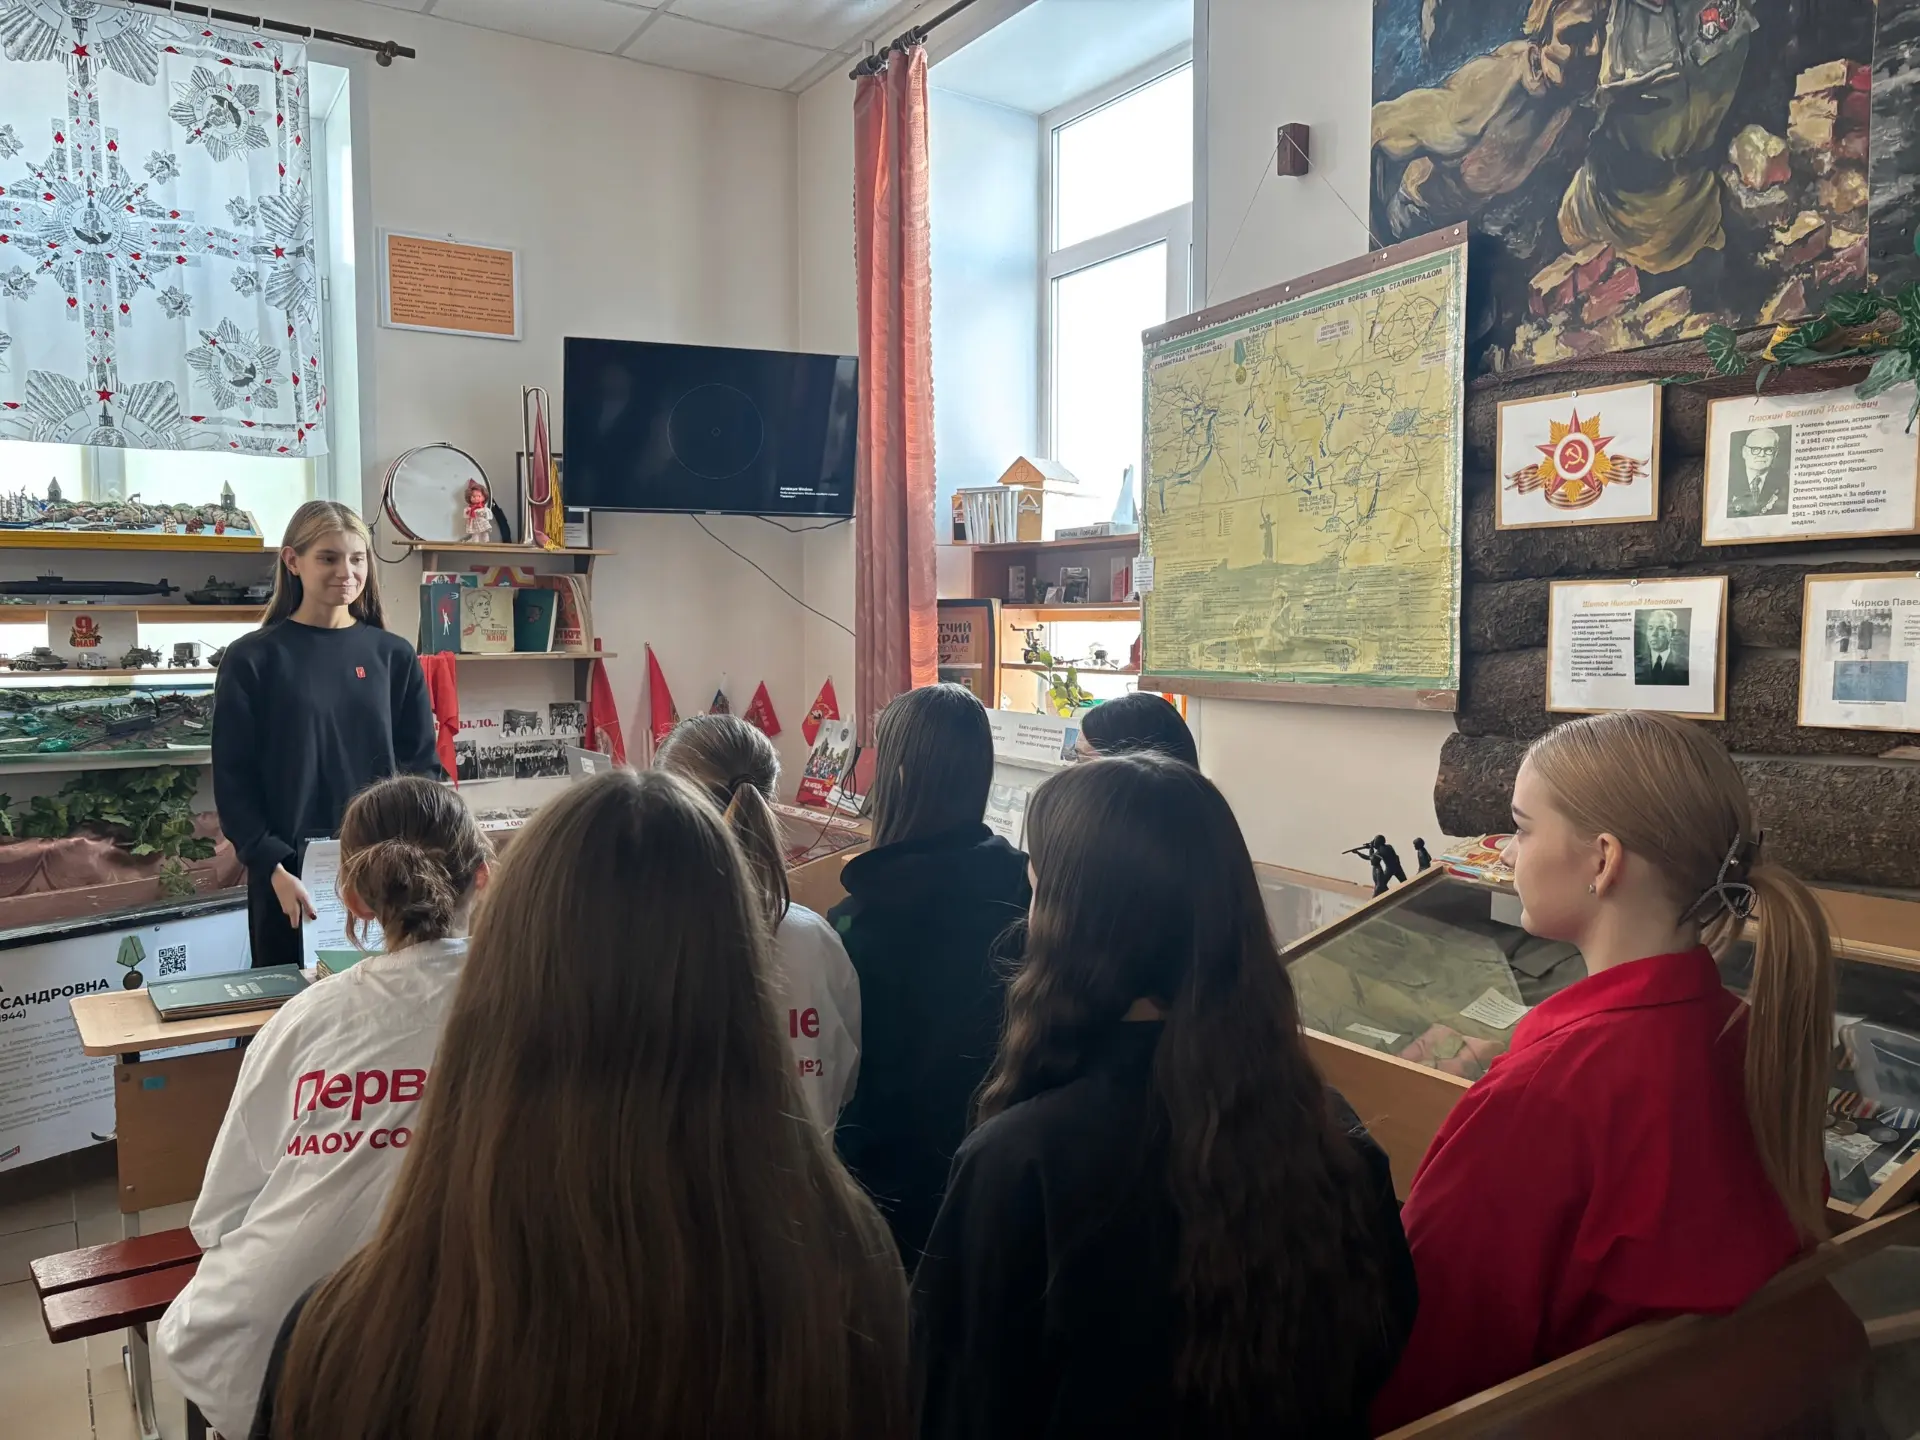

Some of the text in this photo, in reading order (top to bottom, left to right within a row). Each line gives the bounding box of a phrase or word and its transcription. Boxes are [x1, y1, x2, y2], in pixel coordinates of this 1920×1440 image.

[1249, 321, 1272, 334] РАЗГРОМ
[1372, 287, 1385, 296] ПОД
[1389, 268, 1442, 290] СТАЛИНГРАДОМ
[1785, 405, 1824, 418] Василий
[1851, 599, 1889, 608] Чирков
[75, 615, 92, 636] 9
[938, 621, 971, 632] ТЧИЙ
[76, 640, 95, 648] МАЯ
[294, 1069, 426, 1121] Перв
[369, 1127, 412, 1149] СО
